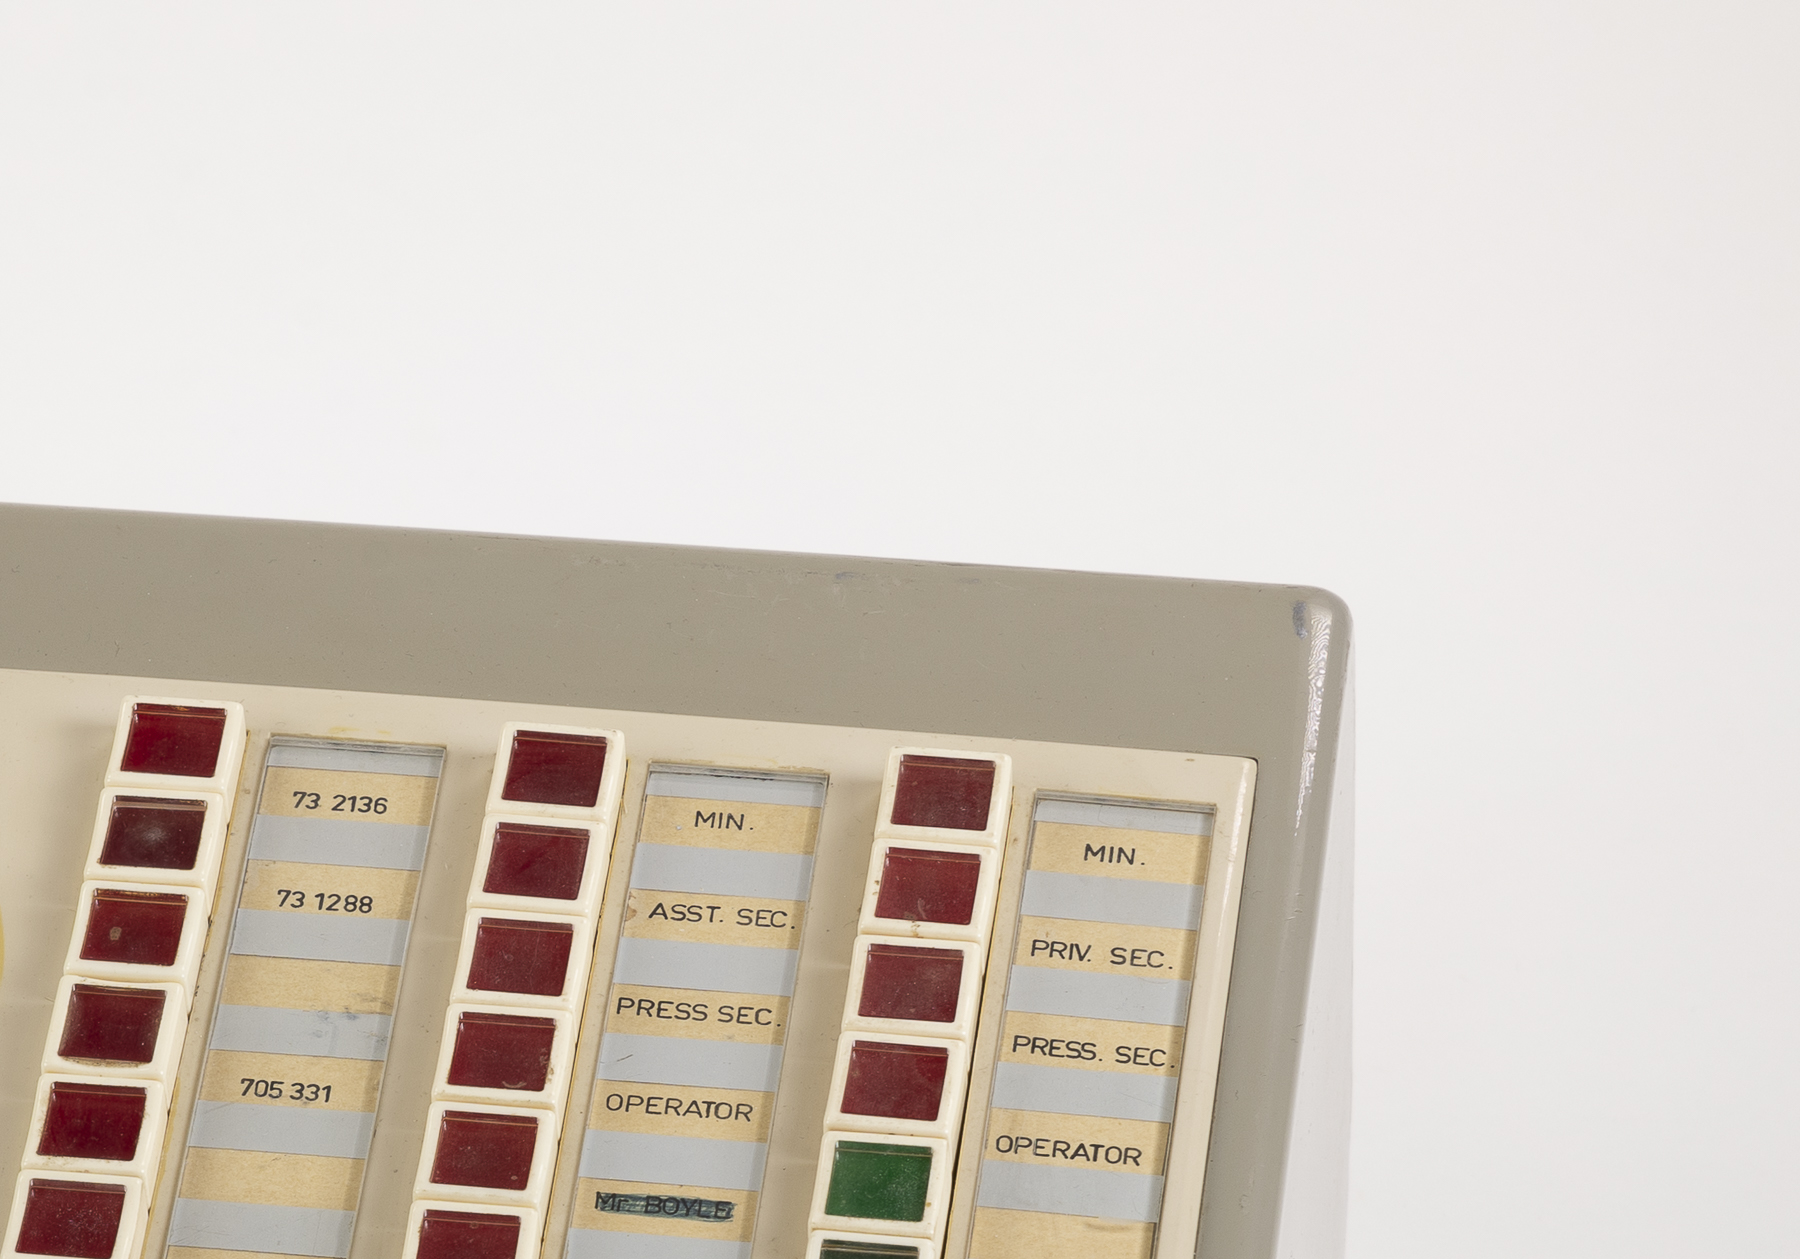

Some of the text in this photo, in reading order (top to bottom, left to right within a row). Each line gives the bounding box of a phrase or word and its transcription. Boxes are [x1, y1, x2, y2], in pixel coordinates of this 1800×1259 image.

[292, 790, 389, 815] 73 2136
[693, 810, 754, 832] MIN.
[1083, 843, 1146, 866] MIN.
[277, 889, 374, 914] 73 1288
[648, 902, 797, 930] ASST. SEC.
[1030, 939, 1174, 970] PRIV. SEC.
[616, 996, 782, 1028] PRESS SEC.
[1012, 1034, 1176, 1069] PRESS. SEC.
[240, 1077, 332, 1103] 705 331
[606, 1093, 754, 1123] OPERATOR
[995, 1135, 1143, 1167] OPERATOR
